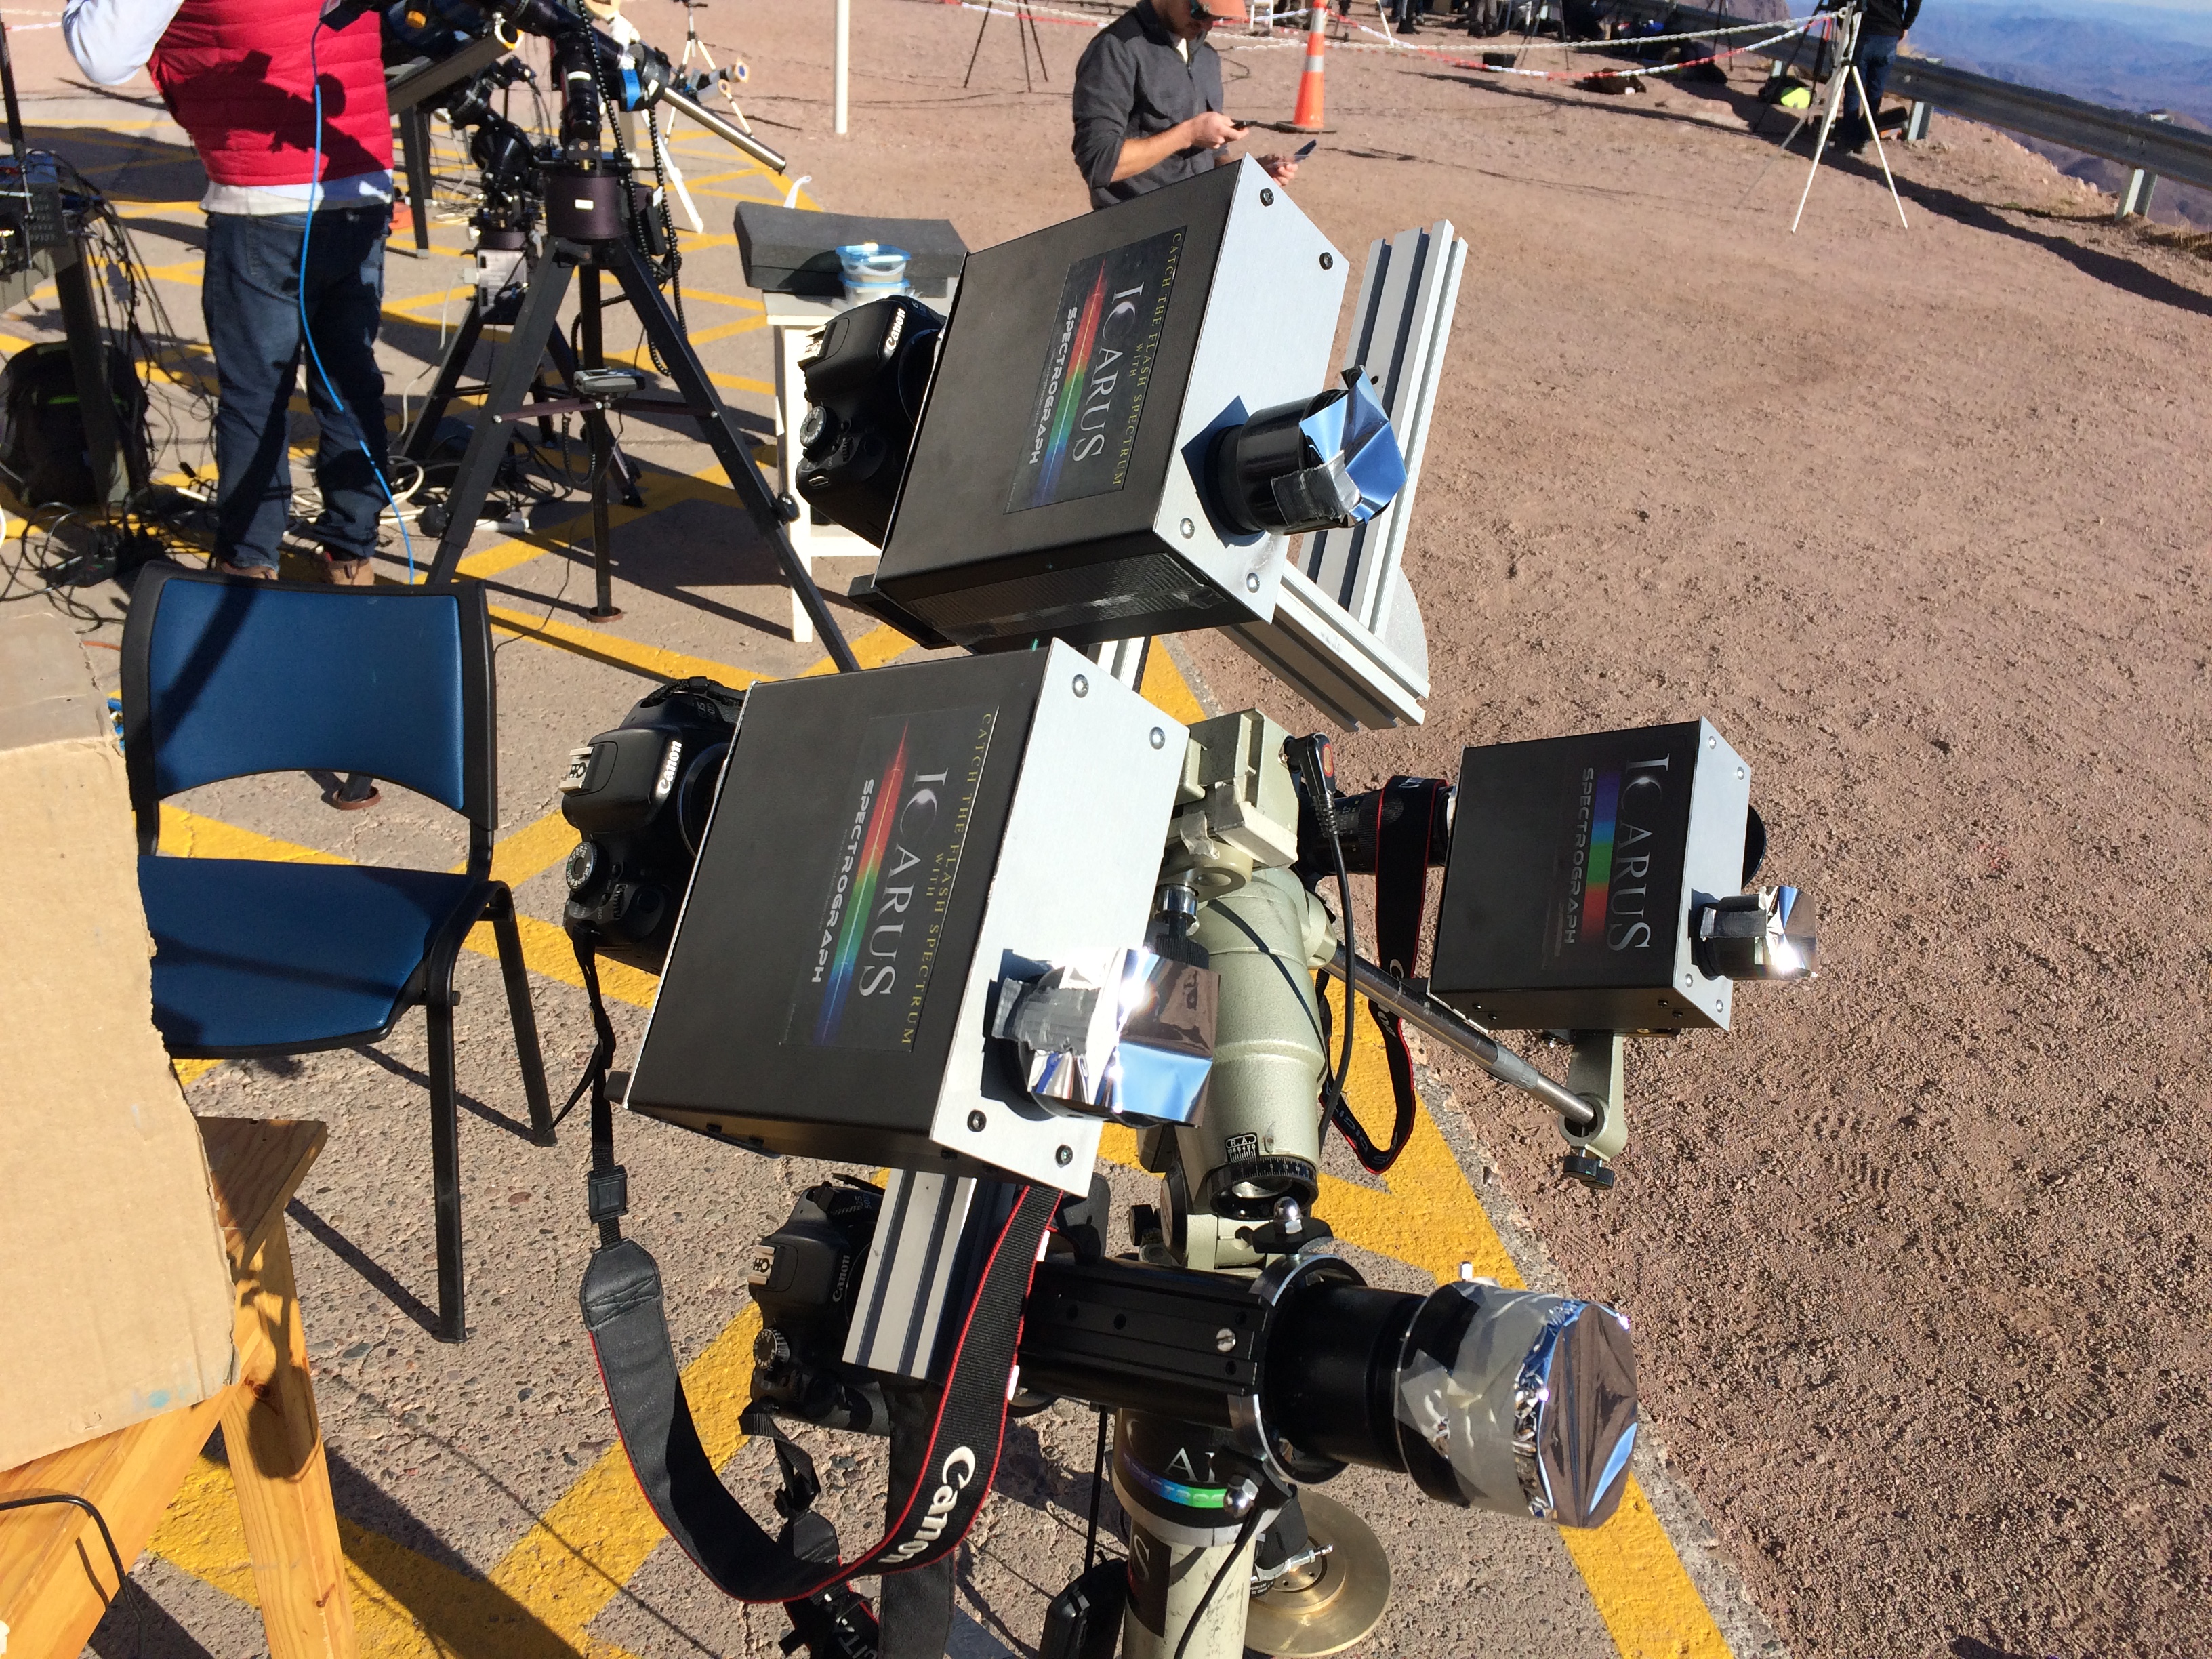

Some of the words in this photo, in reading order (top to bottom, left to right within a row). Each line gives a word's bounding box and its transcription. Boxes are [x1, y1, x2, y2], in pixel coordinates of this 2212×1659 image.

[1161, 232, 1182, 288] CATCH
[885, 308, 906, 350] Canon
[1151, 293, 1168, 327] THE
[1029, 306, 1078, 465] SPECTROGRAPH
[1072, 281, 1145, 462] ICARUS
[1129, 342, 1144, 377] WITH
[1137, 333, 1158, 387] FLASH
[1112, 394, 1143, 485] SPECTRUM
[657, 741, 682, 794] Canon
[967, 713, 991, 783] CATCH
[954, 792, 972, 834] THE
[811, 779, 874, 983] SPECTROGRAPH
[859, 767, 949, 997] ICARUS
[926, 852, 944, 897] WITH
[935, 844, 960, 913] FLASH
[1563, 767, 1593, 944] SPECTROGRAPH
[1606, 753, 1670, 951] ICARUS
[901, 924, 939, 1044] SPECTRUM
[832, 1254, 850, 1303] Canon
[878, 1446, 976, 1563] Canon
